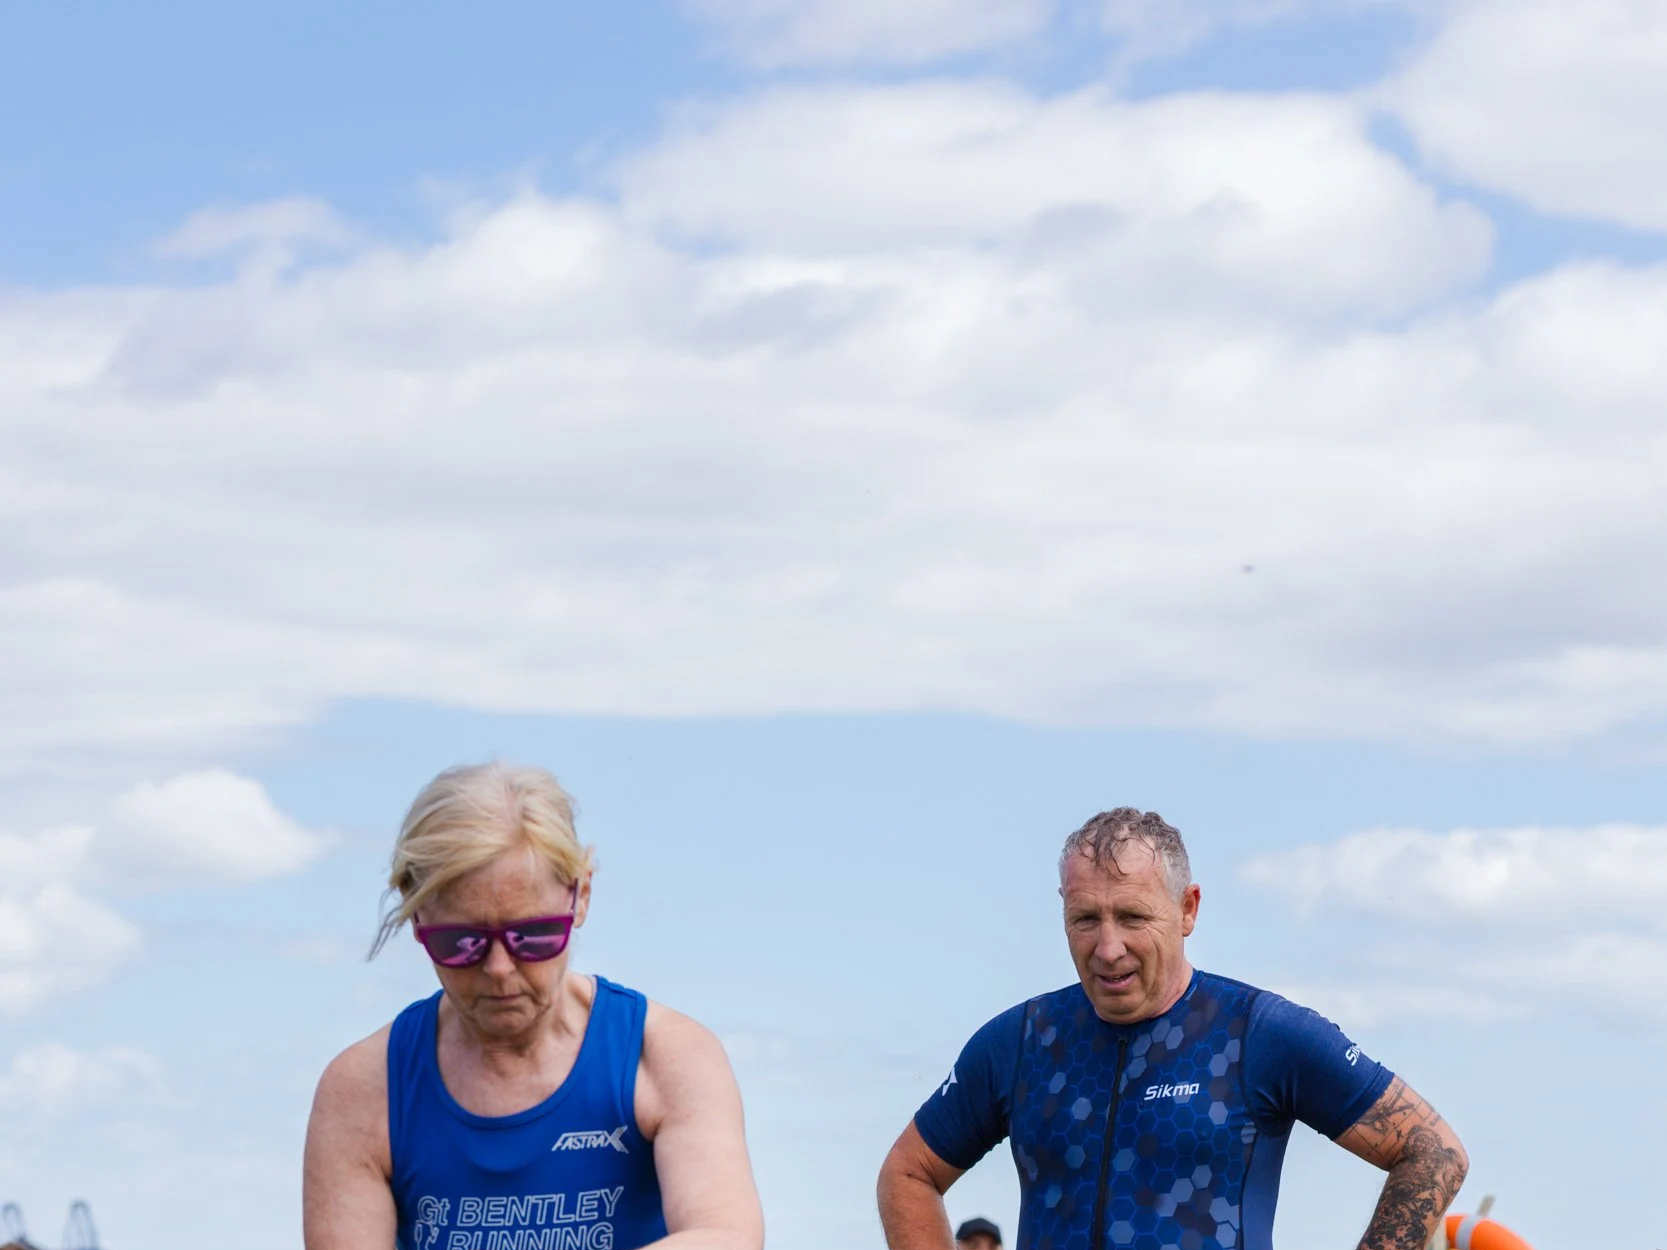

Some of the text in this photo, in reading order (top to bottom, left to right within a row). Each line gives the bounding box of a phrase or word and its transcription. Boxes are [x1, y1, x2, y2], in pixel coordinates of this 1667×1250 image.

[1144, 1082, 1200, 1101] Sikma
[551, 1125, 629, 1154] FASTRAX
[417, 1186, 624, 1227] Gt BENTLEY
